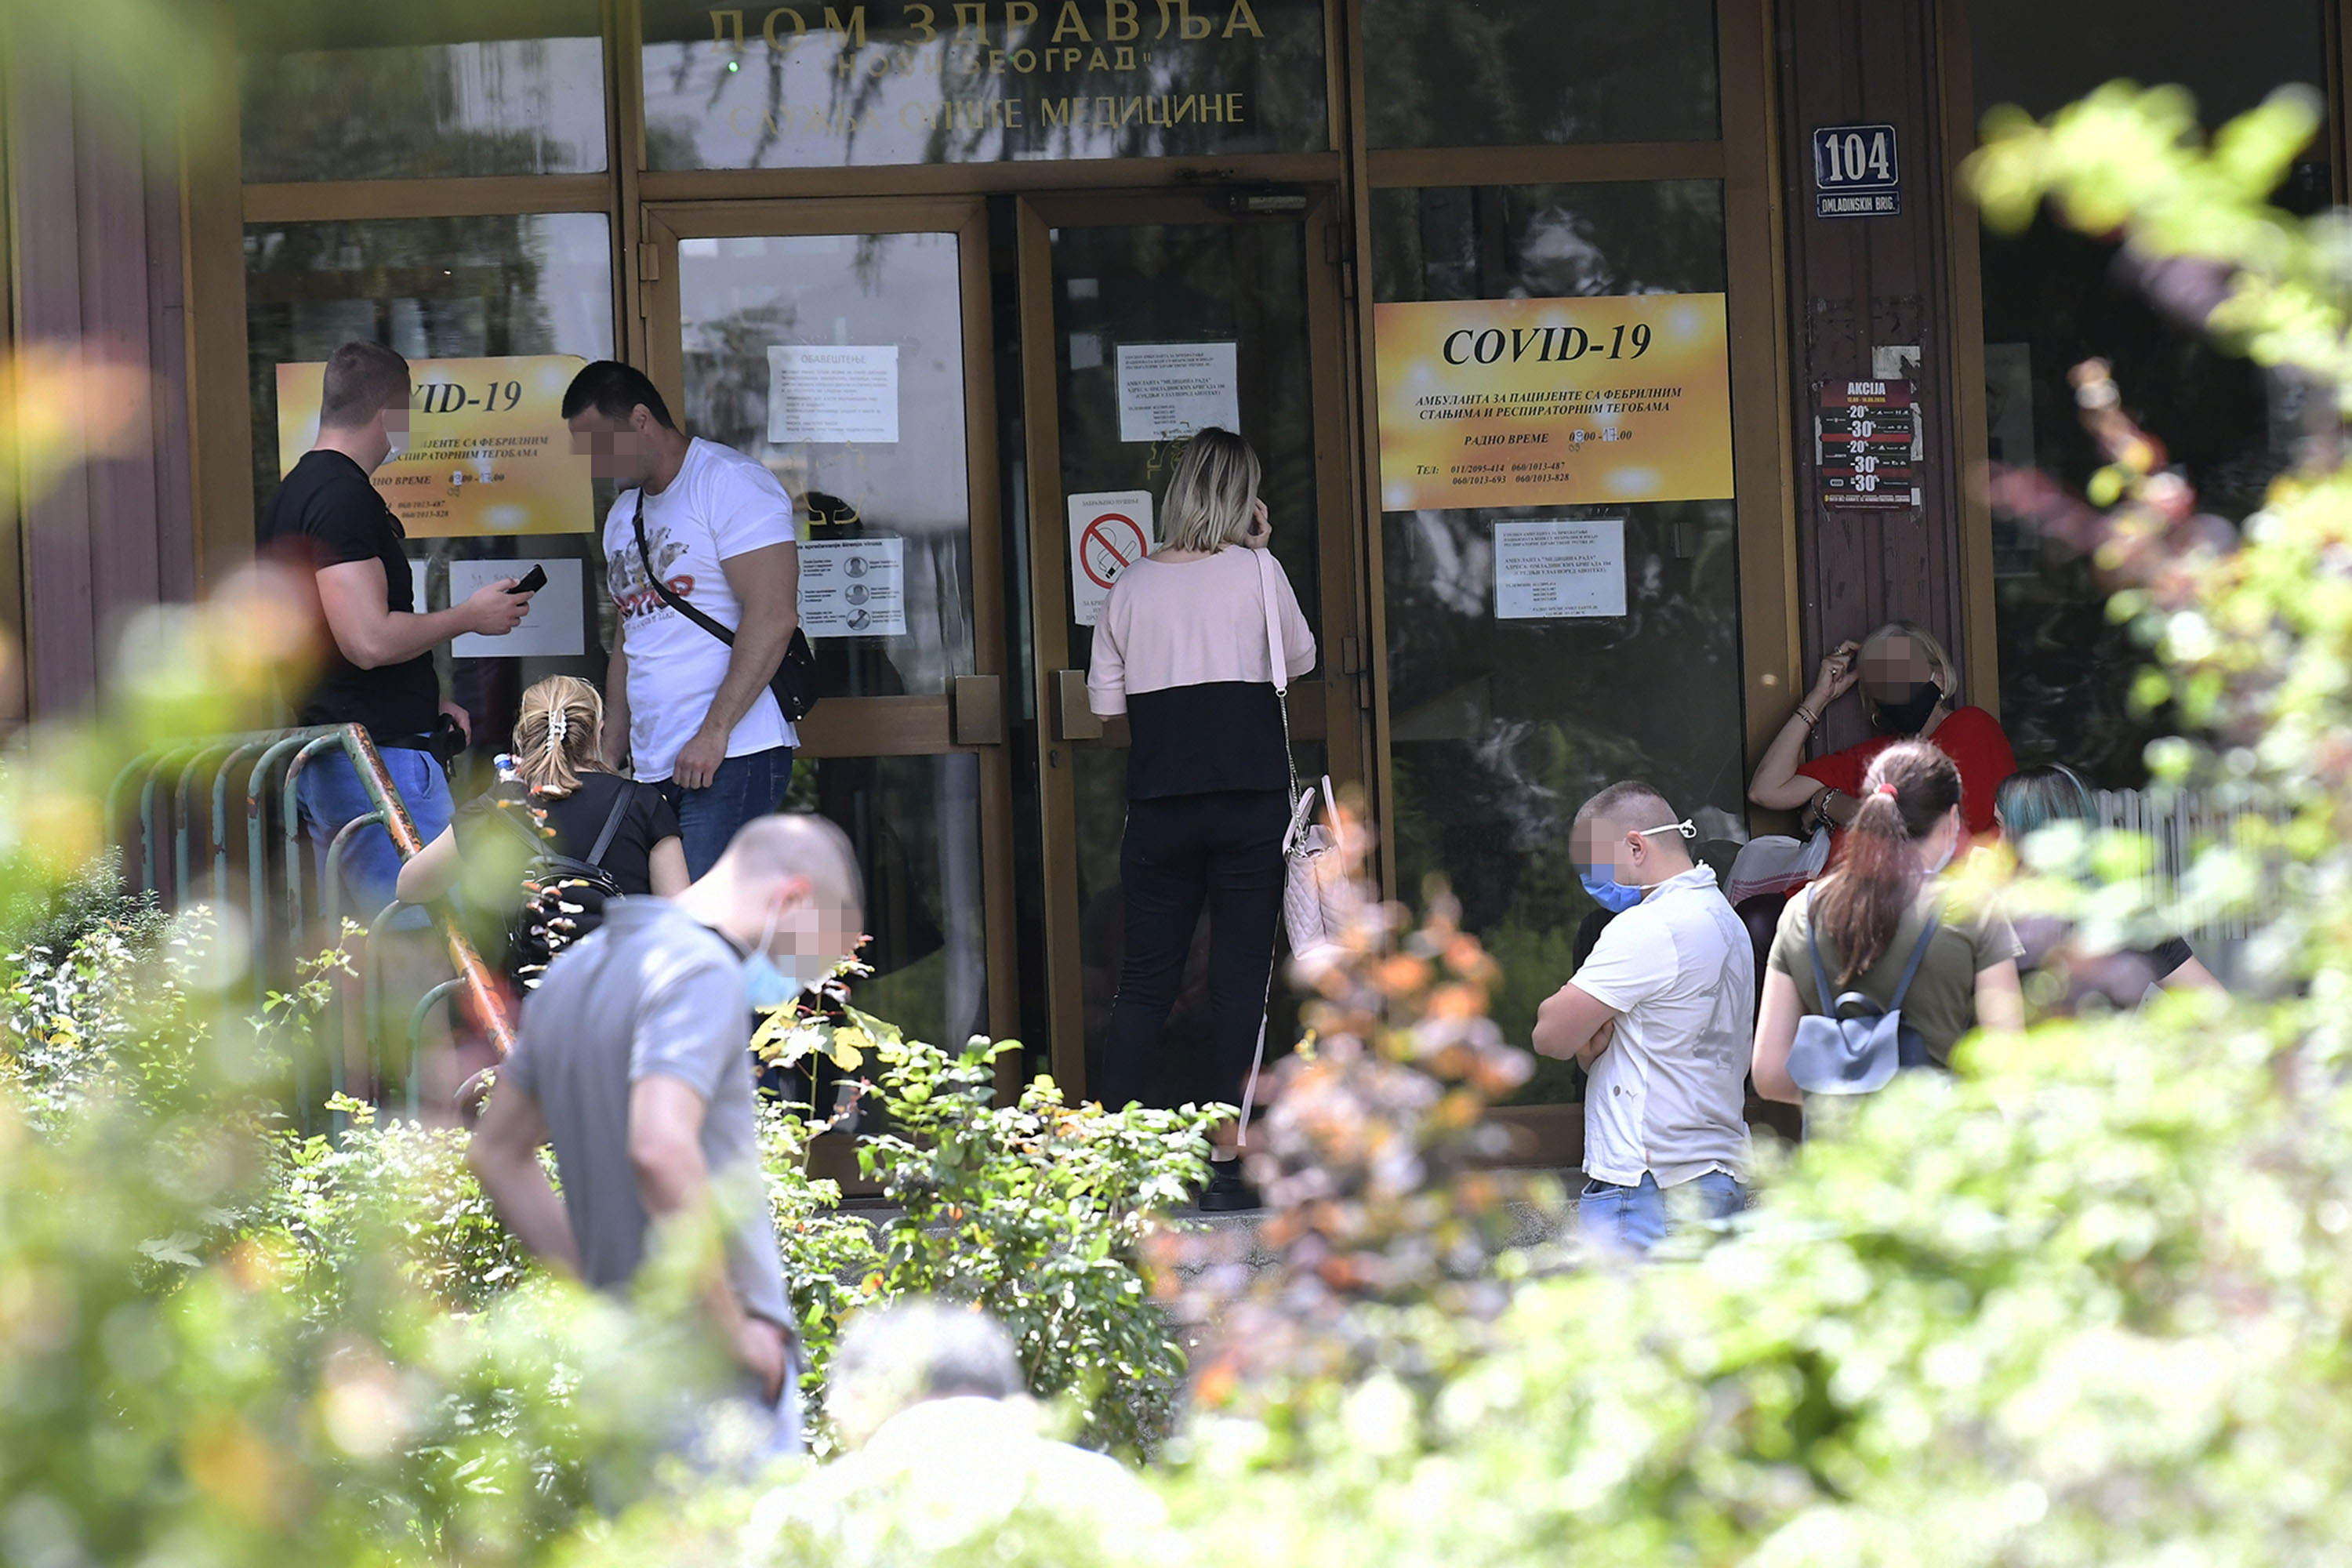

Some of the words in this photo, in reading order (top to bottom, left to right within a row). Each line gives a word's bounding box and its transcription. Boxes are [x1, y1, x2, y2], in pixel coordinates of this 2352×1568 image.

[709, 4, 866, 53] ДОМ
[903, 0, 1265, 47] ЗДРАВЉА
[728, 99, 882, 138] СЛУЖБА
[898, 93, 1023, 132] ОПШТЕ
[1040, 93, 1245, 129] МЕДИЦИНЕ
[1824, 132, 1890, 182] 104
[1821, 197, 1873, 212] OMLADINSKIH
[1875, 196, 1896, 211] BRIG.
[1442, 323, 1653, 365] COVID-19
[800, 354, 866, 365] ОБАВЕШТЕЊЕ
[1847, 382, 1886, 395] AKCIJA
[411, 380, 522, 414] ID-19
[1415, 394, 1490, 406] АМБУЛАНТА
[1492, 393, 1508, 404] ЗА
[1509, 390, 1583, 404] ПАЦИЈЕНТЕ
[1585, 390, 1602, 401] СА
[1603, 387, 1682, 400] ФЕБРИЛНИМ
[1419, 408, 1481, 420] СТАЊИМА
[1483, 407, 1494, 418] И
[1496, 404, 1604, 418] РЕСПИРАТОРНИМ
[1606, 401, 1671, 414] ТЕГОБАМА
[463, 437, 477, 448] СА
[479, 436, 549, 447] ФЕБРИЛНИМ
[1464, 434, 1507, 447] РАДНО
[1509, 433, 1549, 445] ВРЕМЕ
[397, 448, 480, 461] СПИРАТОРНИМ
[482, 448, 538, 459] ТЕГОБАМА
[1450, 464, 1504, 474] 011/2095-414
[1512, 462, 1566, 472] 060/1013-487
[394, 475, 431, 486] ВРЕМЕ
[1452, 475, 1506, 485] 060/1013-693
[1515, 473, 1570, 483] 060/1013-828
